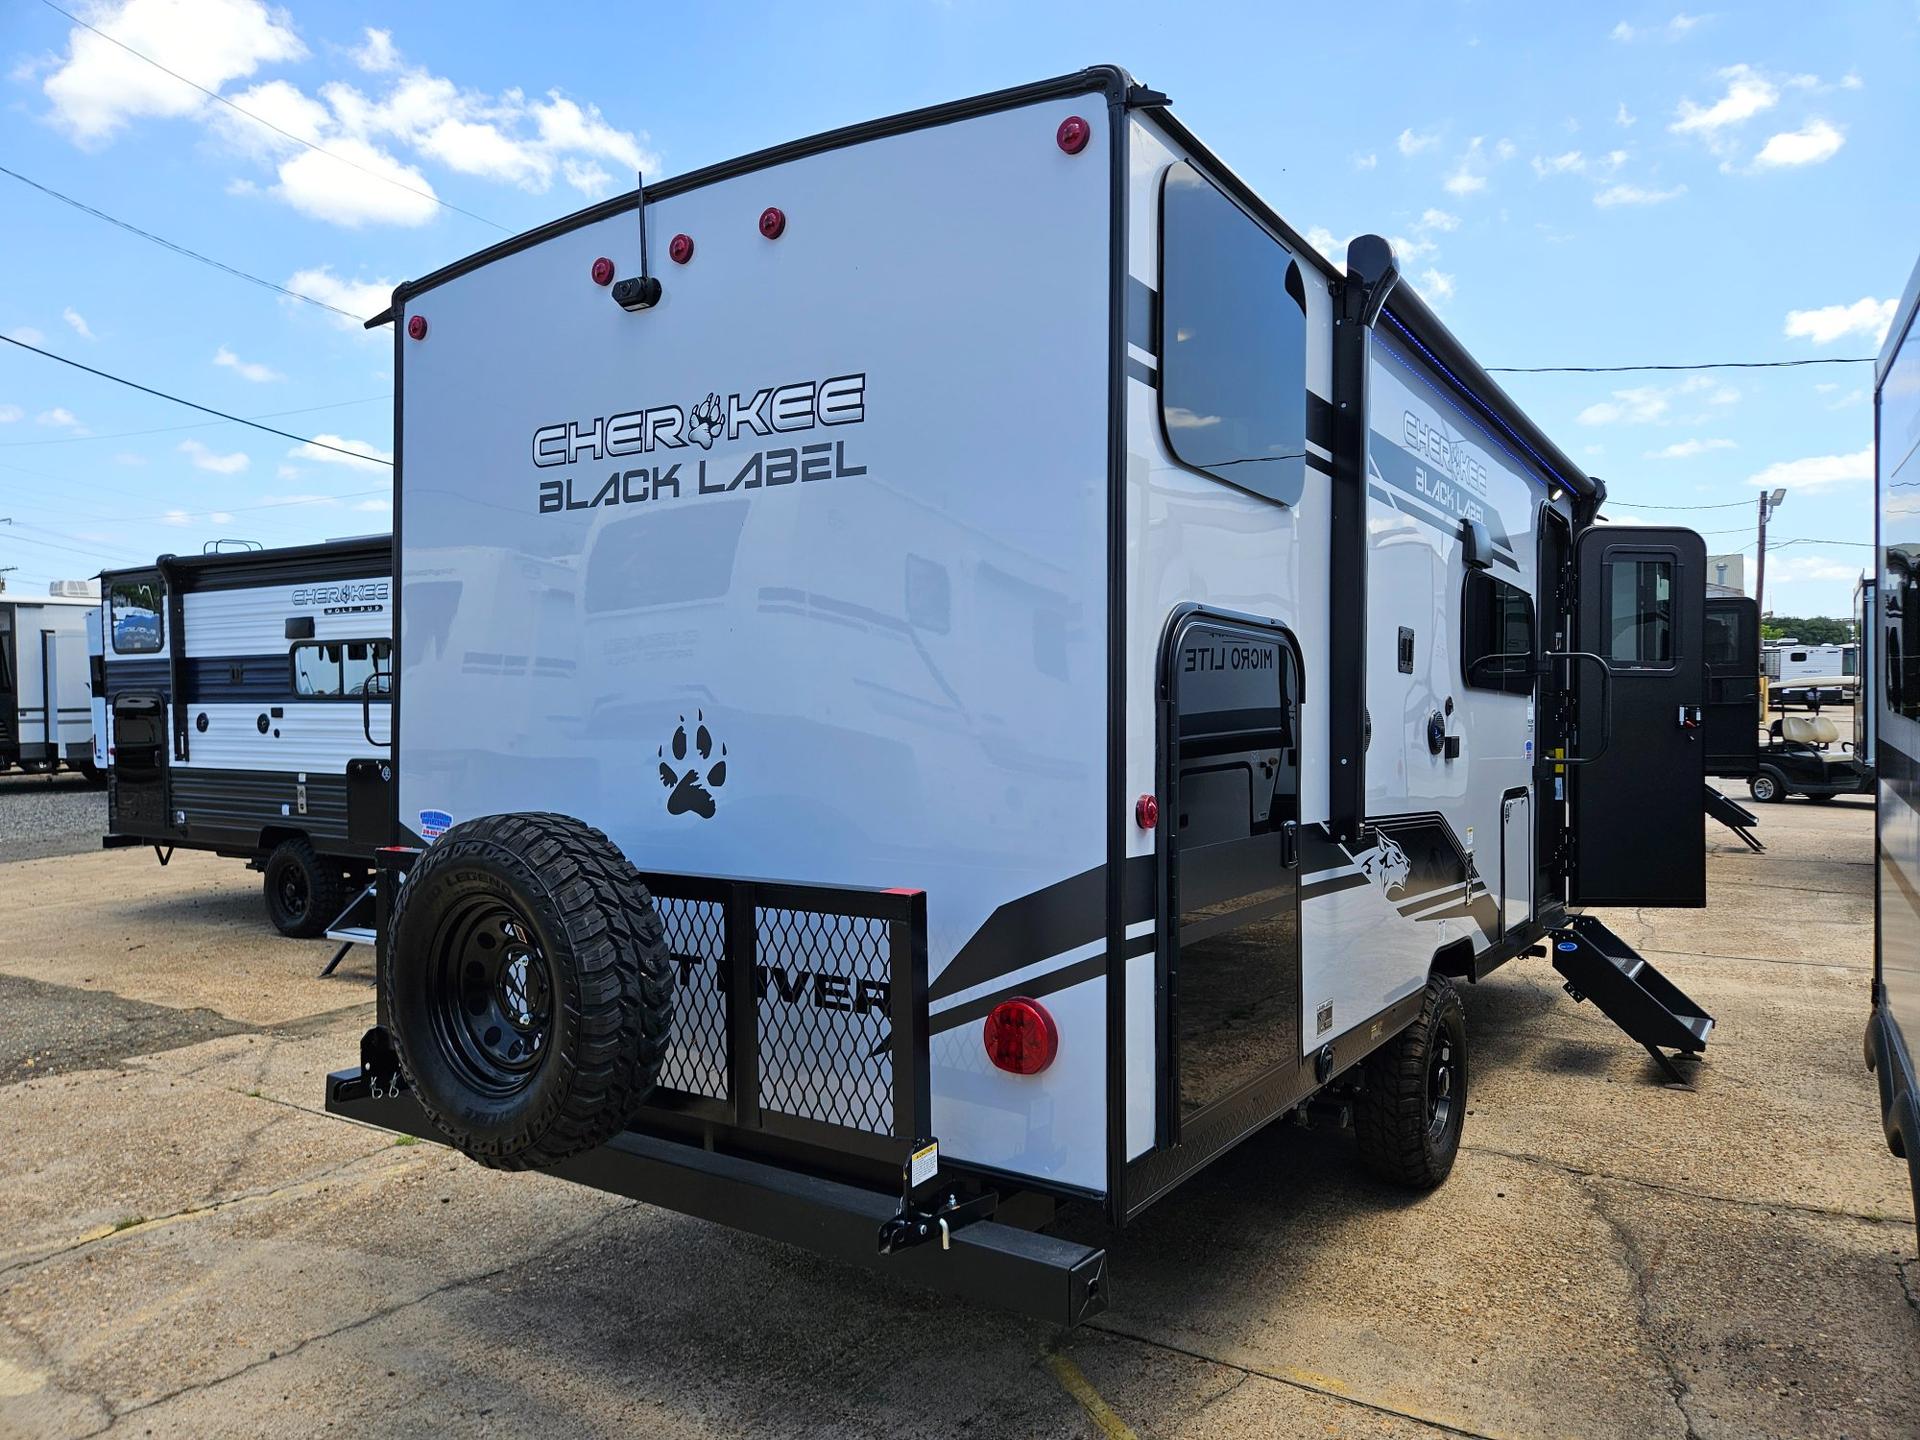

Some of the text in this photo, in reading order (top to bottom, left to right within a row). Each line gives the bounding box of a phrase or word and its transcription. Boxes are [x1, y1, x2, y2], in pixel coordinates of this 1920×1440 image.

[539, 440, 868, 514] BLACK LABEL
[1415, 466, 1484, 524] BLACK LABEL
[717, 958, 891, 1018] IVER
